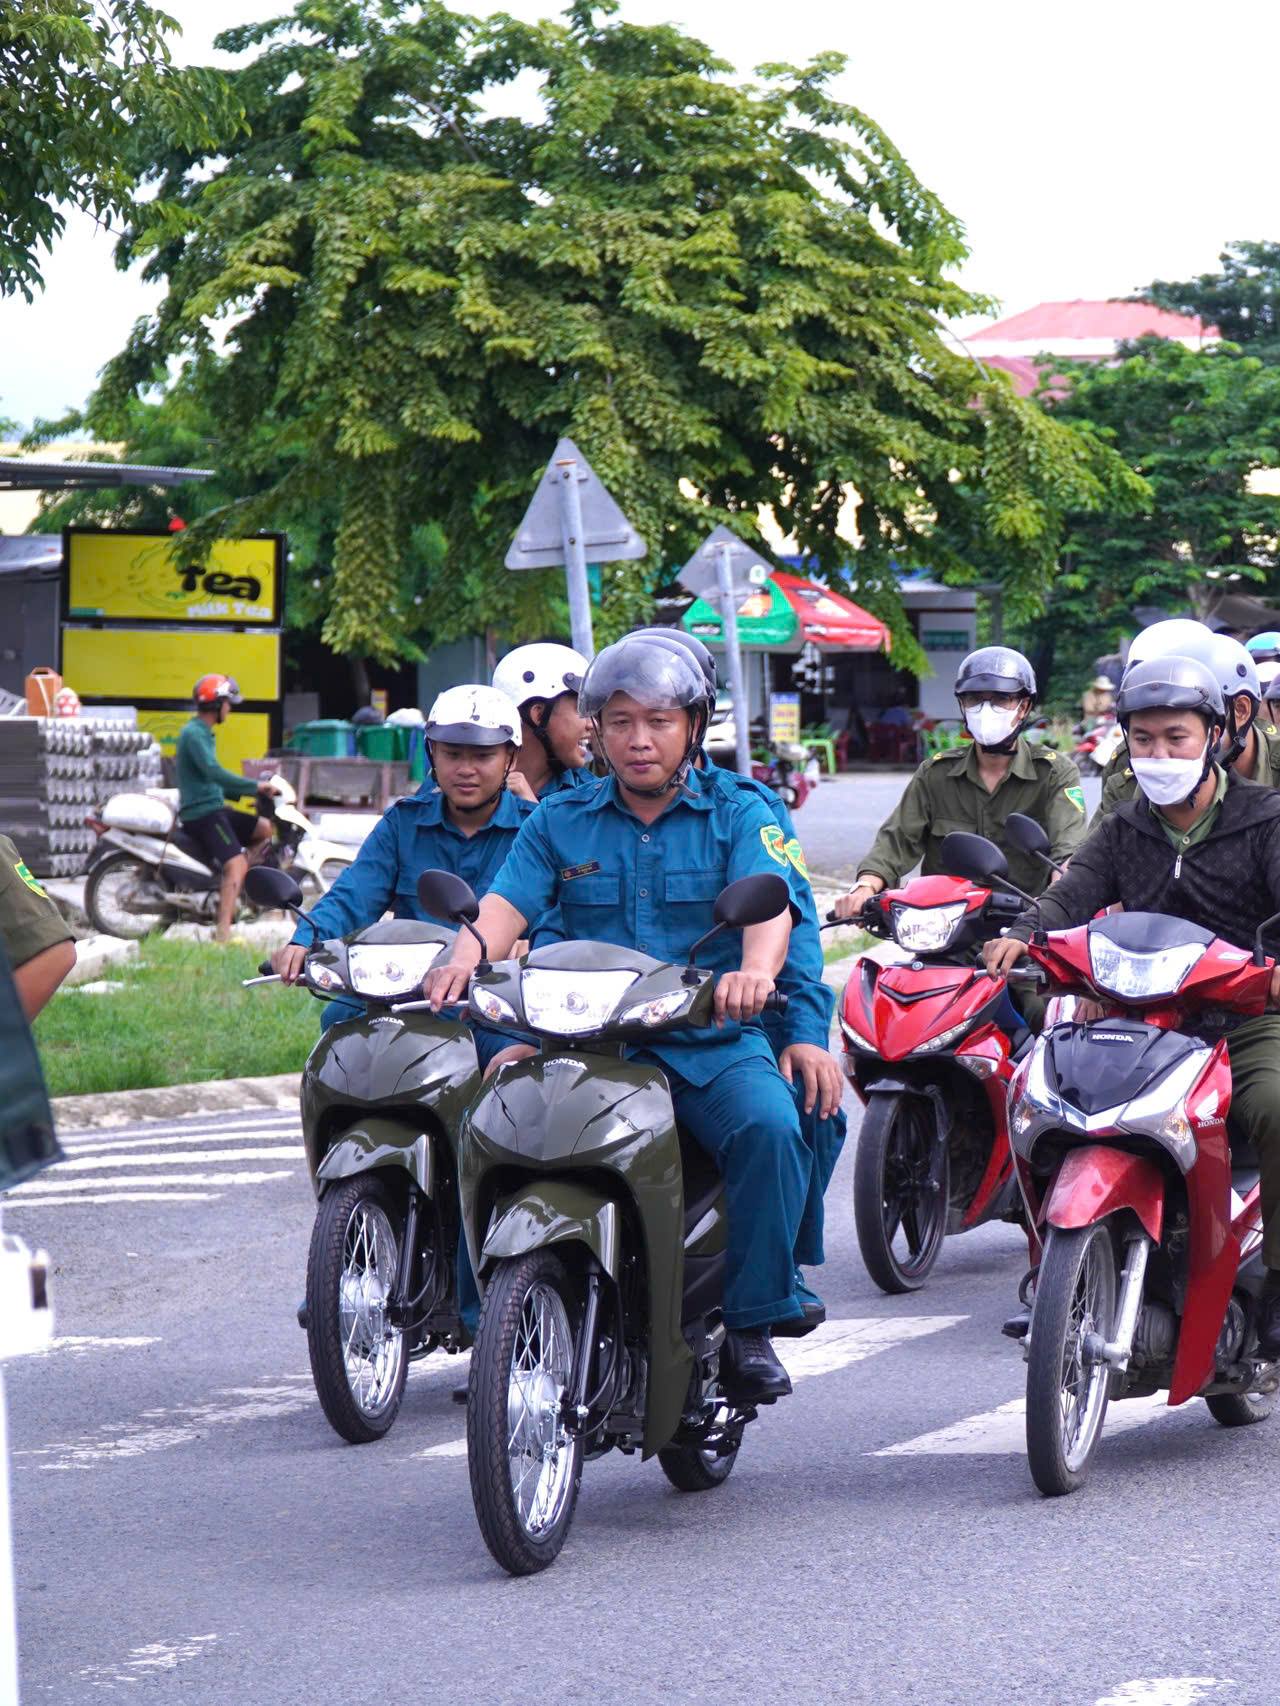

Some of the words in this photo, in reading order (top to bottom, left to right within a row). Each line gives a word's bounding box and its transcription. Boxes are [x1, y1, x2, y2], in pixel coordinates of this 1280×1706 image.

[178, 565, 260, 601] Tea
[368, 1015, 405, 1026] HONDA
[1092, 1033, 1134, 1043] HONDA
[542, 1057, 588, 1070] HONDA
[1197, 1117, 1226, 1128] HONDA
